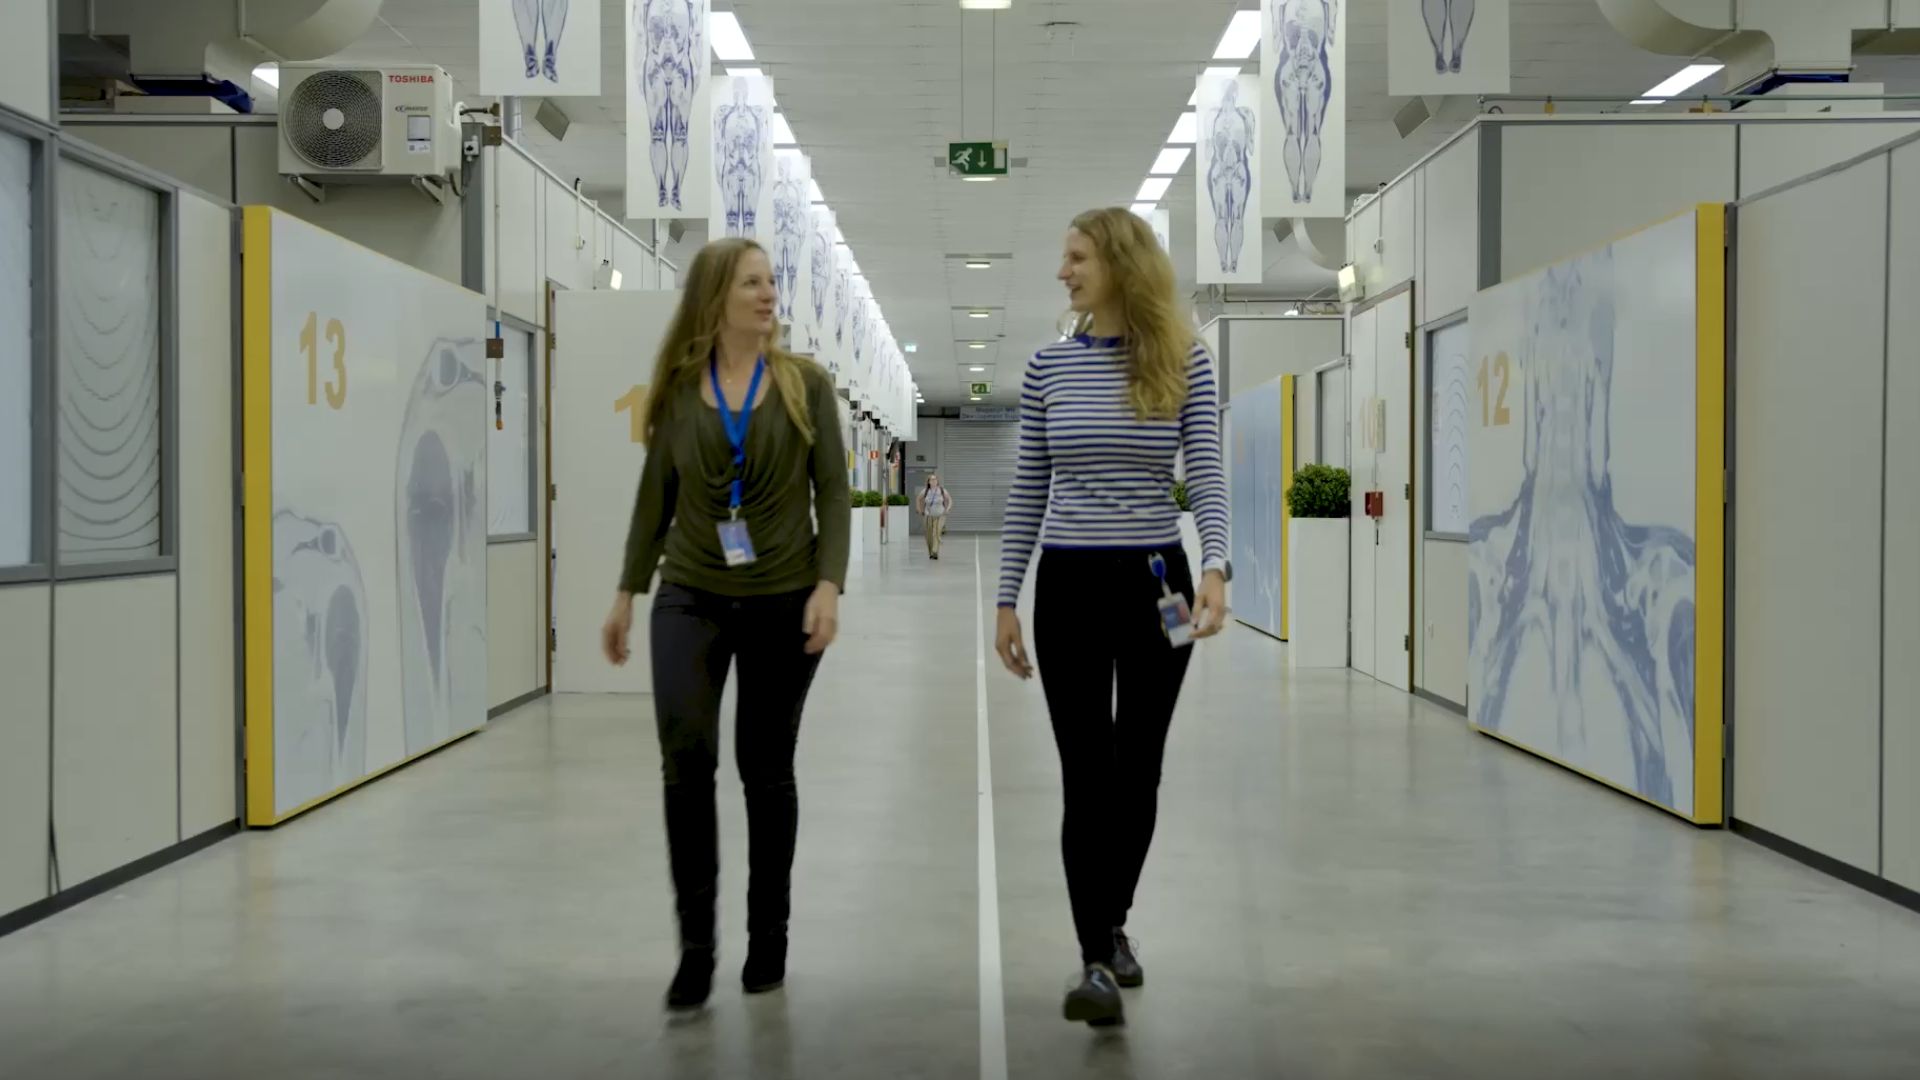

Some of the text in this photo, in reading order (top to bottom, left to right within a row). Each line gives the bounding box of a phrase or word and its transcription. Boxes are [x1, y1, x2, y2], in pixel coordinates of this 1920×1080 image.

[388, 75, 433, 83] TOSHIBA
[299, 310, 347, 410] 13
[1476, 351, 1510, 427] 12
